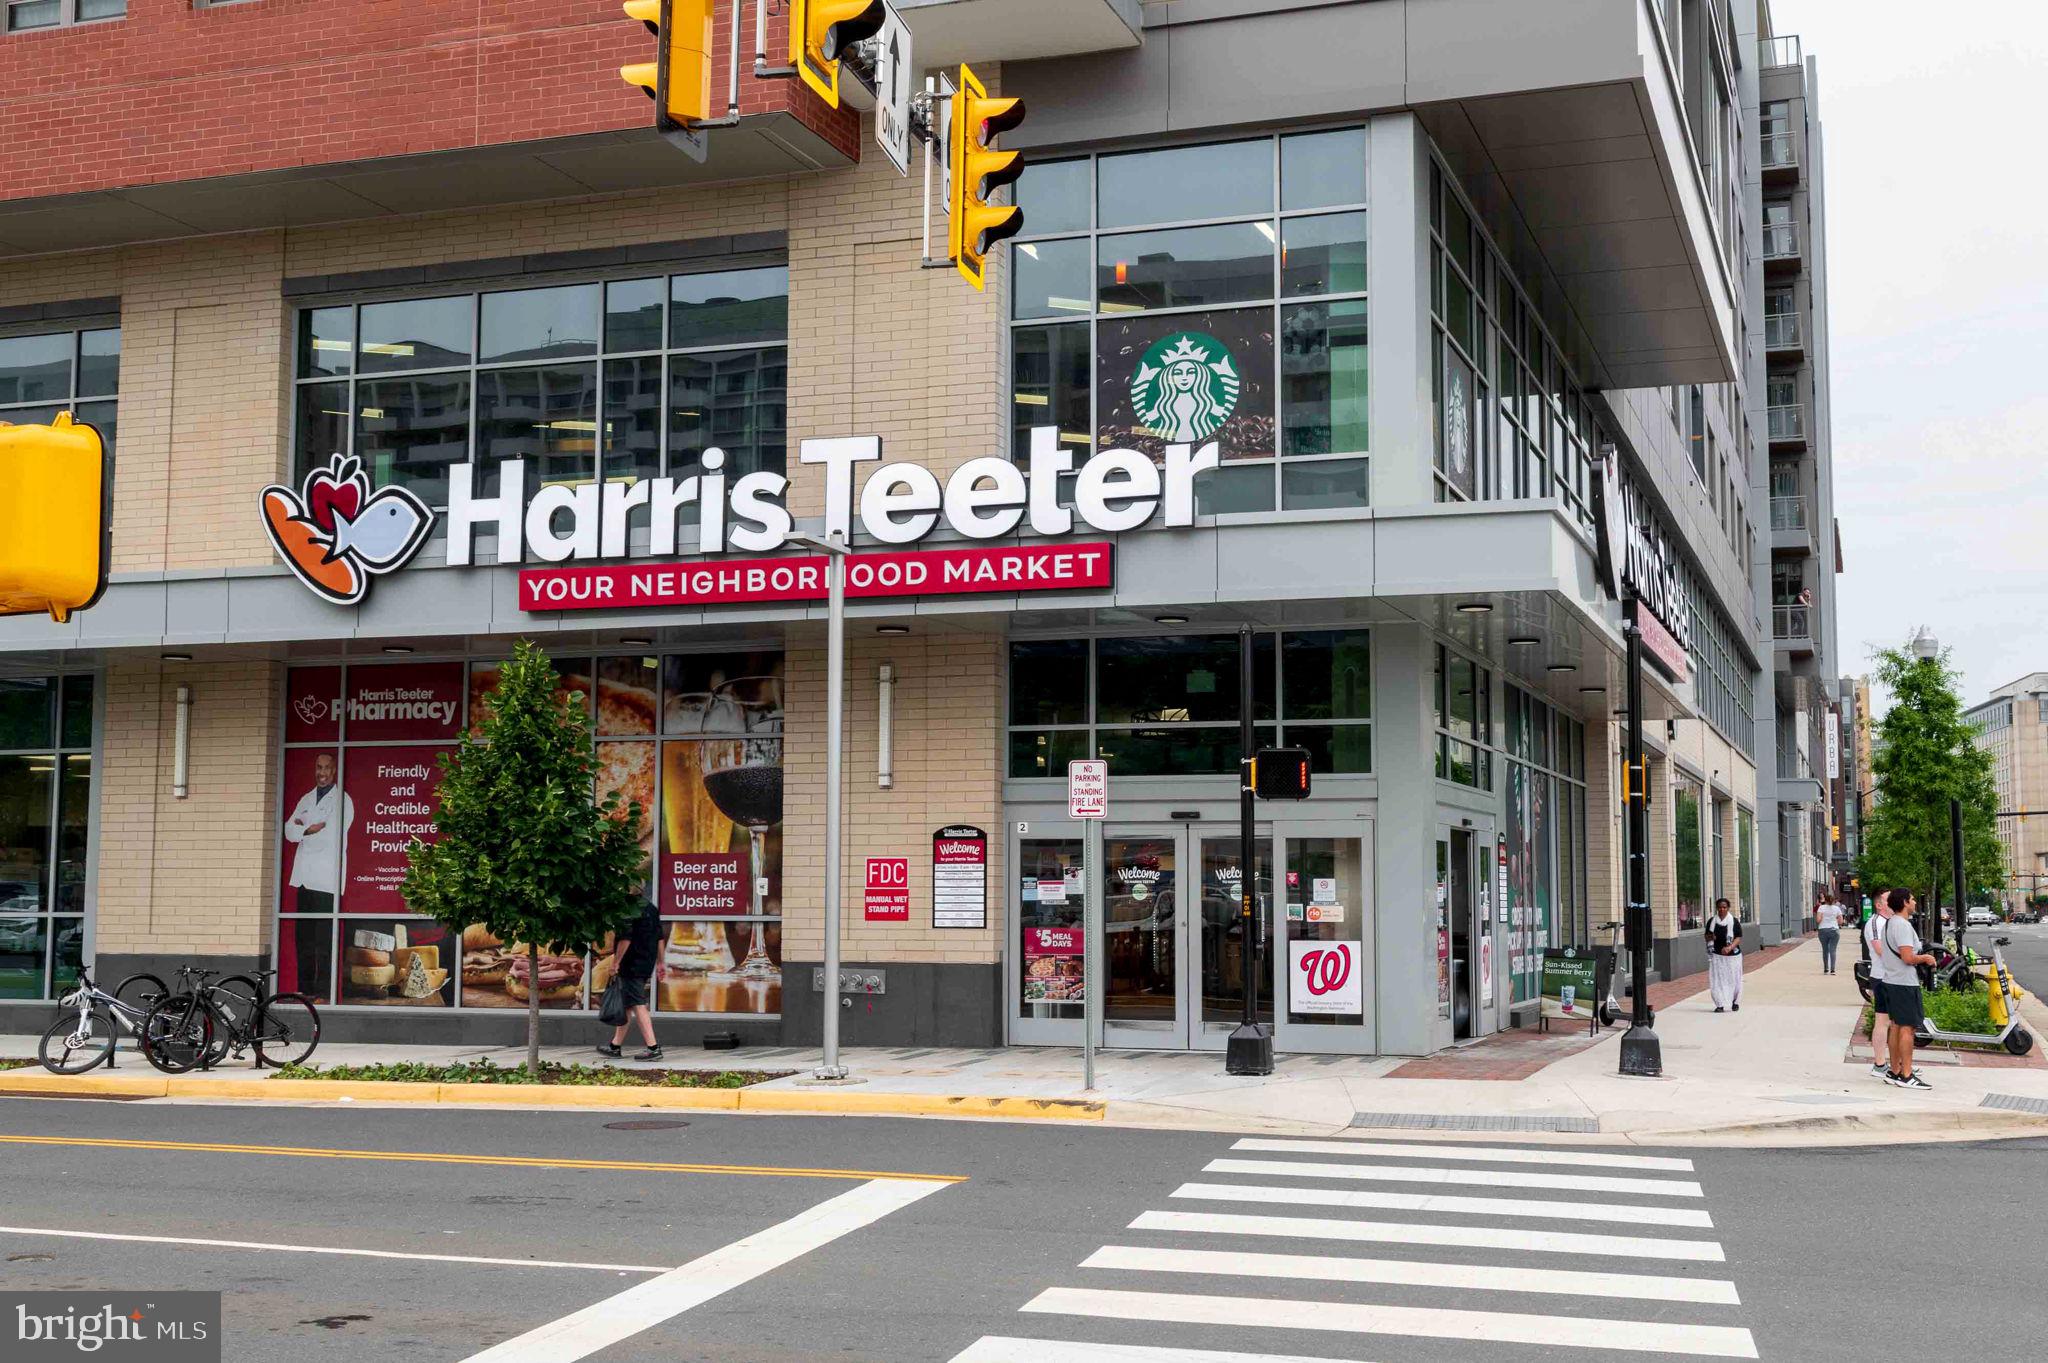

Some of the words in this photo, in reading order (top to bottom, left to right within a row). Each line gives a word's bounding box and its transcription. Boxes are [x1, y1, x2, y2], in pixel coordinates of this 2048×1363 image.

[882, 106, 903, 152] ONLY
[446, 447, 794, 566] Harris
[800, 426, 1220, 545] Teeter
[528, 575, 614, 601] YOUR
[944, 552, 1101, 583] MARKET
[359, 689, 395, 701] Harris
[395, 688, 434, 700] Teeter
[331, 698, 457, 725] Pharmacy
[377, 764, 430, 780] Friendly
[1083, 765, 1093, 773] NO
[1074, 774, 1102, 783] PARKING
[390, 783, 415, 796] and
[1073, 788, 1103, 796] STANDING
[374, 802, 430, 815] Credible
[1072, 797, 1086, 806] FIRE
[1087, 797, 1104, 807] LANE
[366, 821, 438, 834] Healthcare
[1019, 823, 1026, 832] 2
[939, 841, 980, 856] Welcome
[674, 861, 707, 874] Beer
[710, 861, 737, 873] and
[869, 863, 904, 884] FDC
[1117, 866, 1161, 881] Welcome
[673, 878, 710, 891] Wine
[713, 878, 738, 890] Bar
[675, 894, 734, 911] Upstairs
[1036, 929, 1052, 947] $5
